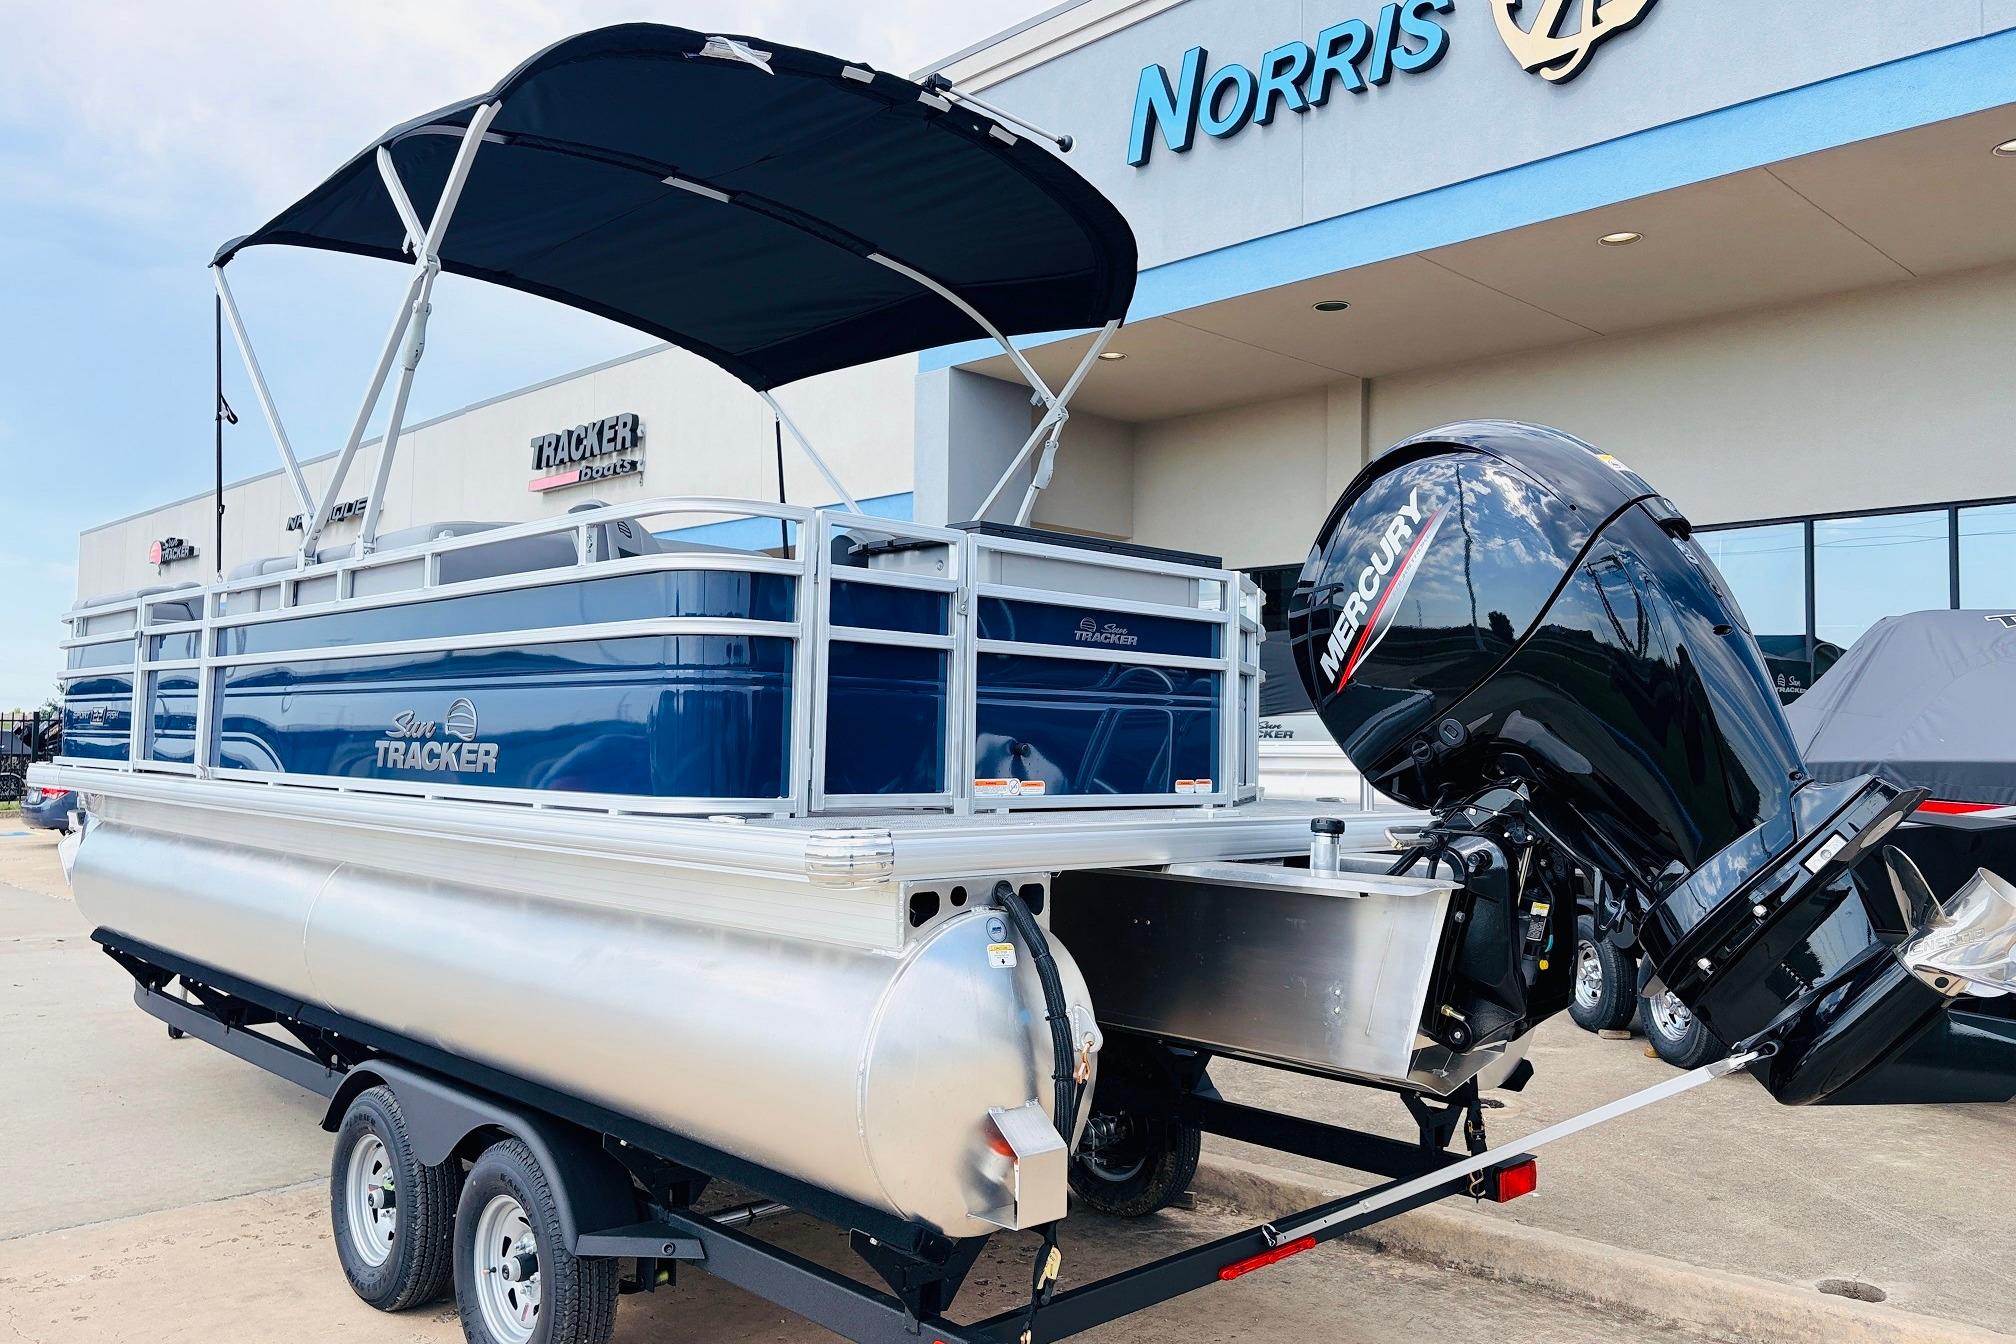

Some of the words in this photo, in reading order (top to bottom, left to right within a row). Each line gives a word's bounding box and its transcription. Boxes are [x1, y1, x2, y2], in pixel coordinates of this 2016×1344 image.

[1126, 0, 1455, 169] NORRIS
[530, 412, 640, 470] TRACKER
[580, 459, 636, 481] boats
[161, 546, 192, 564] TRACKER
[1319, 486, 1422, 684] MERCURY
[1074, 630, 1138, 646] TRACKER
[1101, 623, 1128, 634] Sun
[73, 711, 90, 719] SPORT
[106, 711, 119, 719] FISH
[385, 709, 437, 739] Sun
[1258, 720, 1282, 730] Sun
[375, 740, 499, 774] TRACKER
